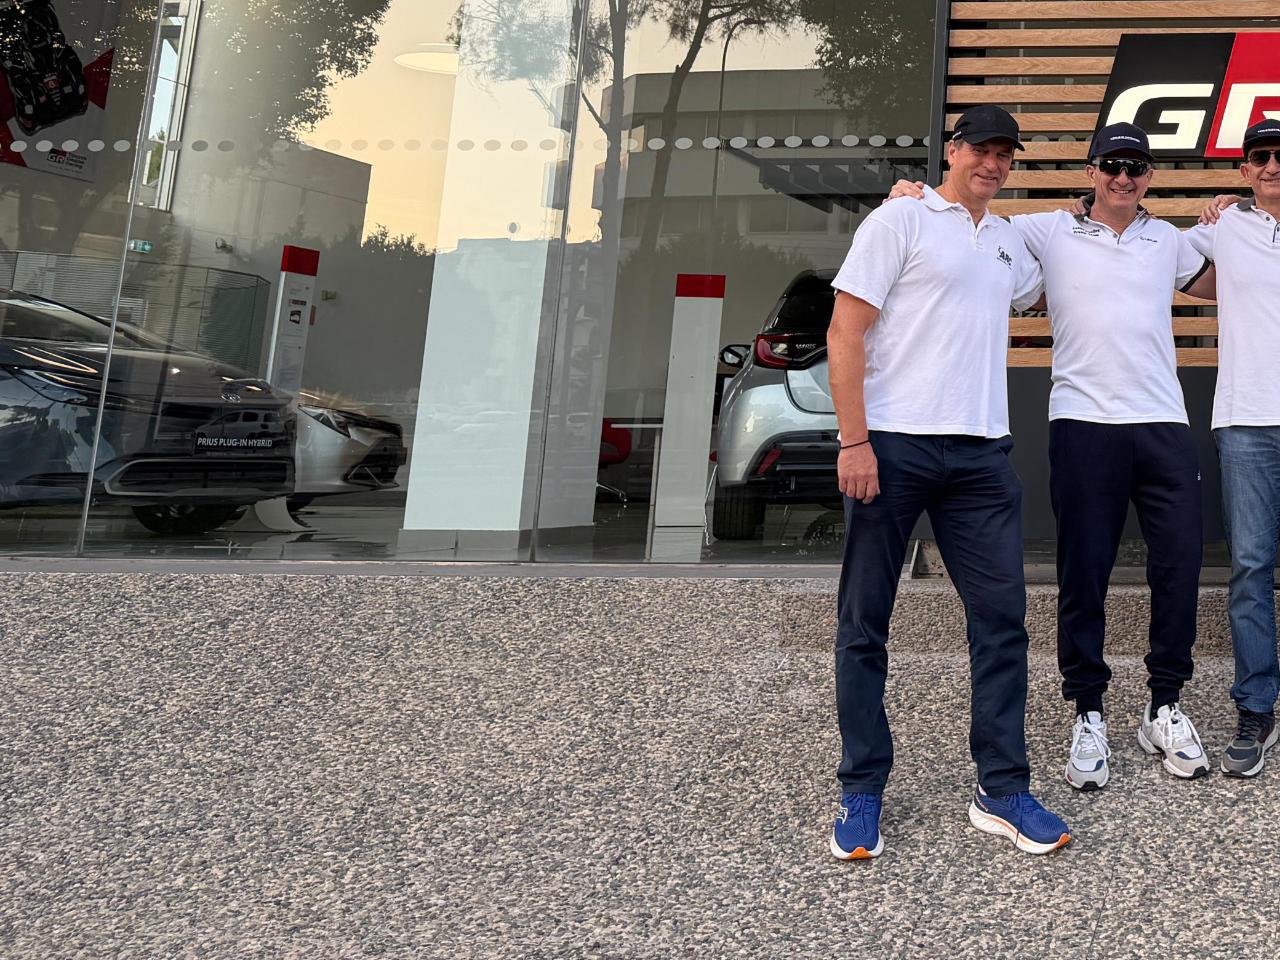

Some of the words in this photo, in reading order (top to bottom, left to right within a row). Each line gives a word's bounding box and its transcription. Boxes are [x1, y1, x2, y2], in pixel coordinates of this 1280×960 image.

[197, 437, 218, 446] PRIUS
[219, 438, 247, 447] PLUG-IN
[248, 439, 273, 447] HYBRID
